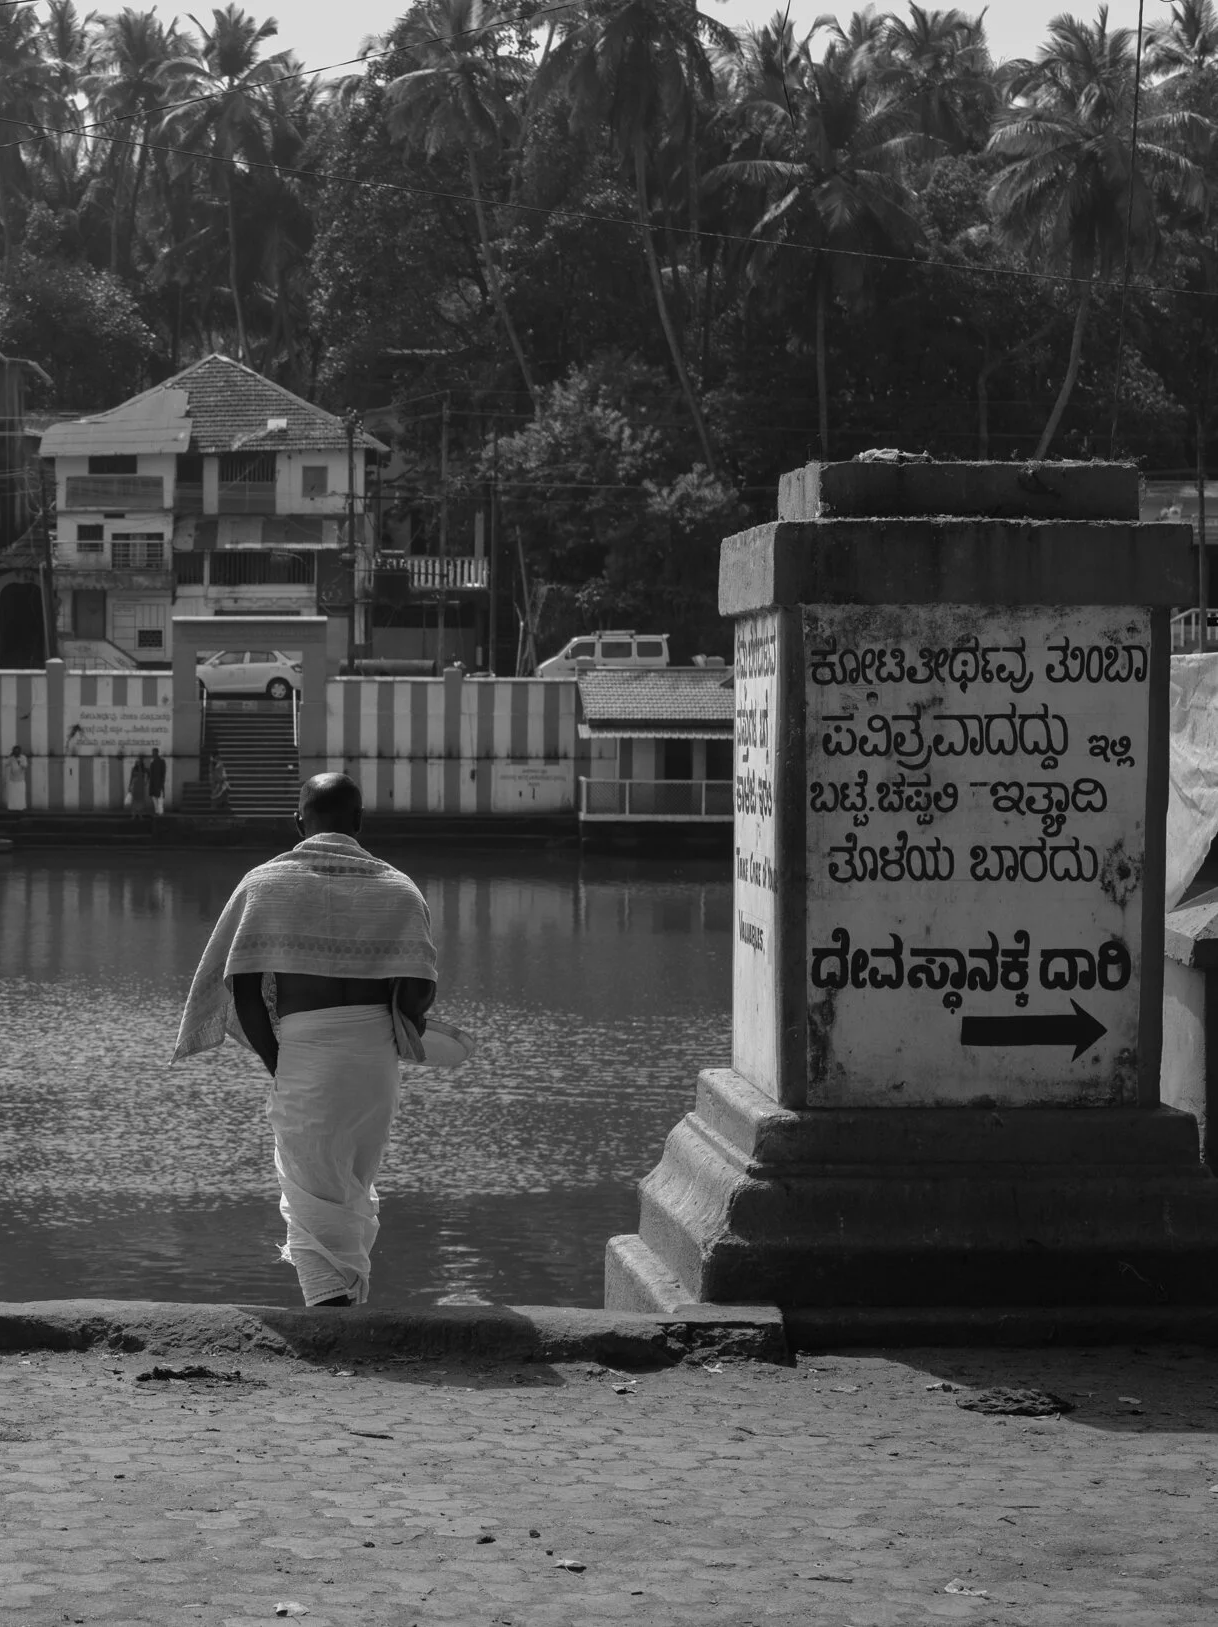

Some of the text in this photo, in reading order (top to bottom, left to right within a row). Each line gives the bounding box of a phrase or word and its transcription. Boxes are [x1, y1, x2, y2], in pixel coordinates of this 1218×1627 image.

[1045, 635, 1148, 682] ತುಂಬಾ
[821, 703, 1136, 771] ಪವಿತ್ರವಾದದ್ದು ಇಲ್ಲಿ
[828, 830, 1099, 882] ತೊಳೆಯ ಬಾರದು
[811, 927, 1132, 1015] ದೇವಸ್ಥಾನಕ್ಕೆ ದಾರಿ
